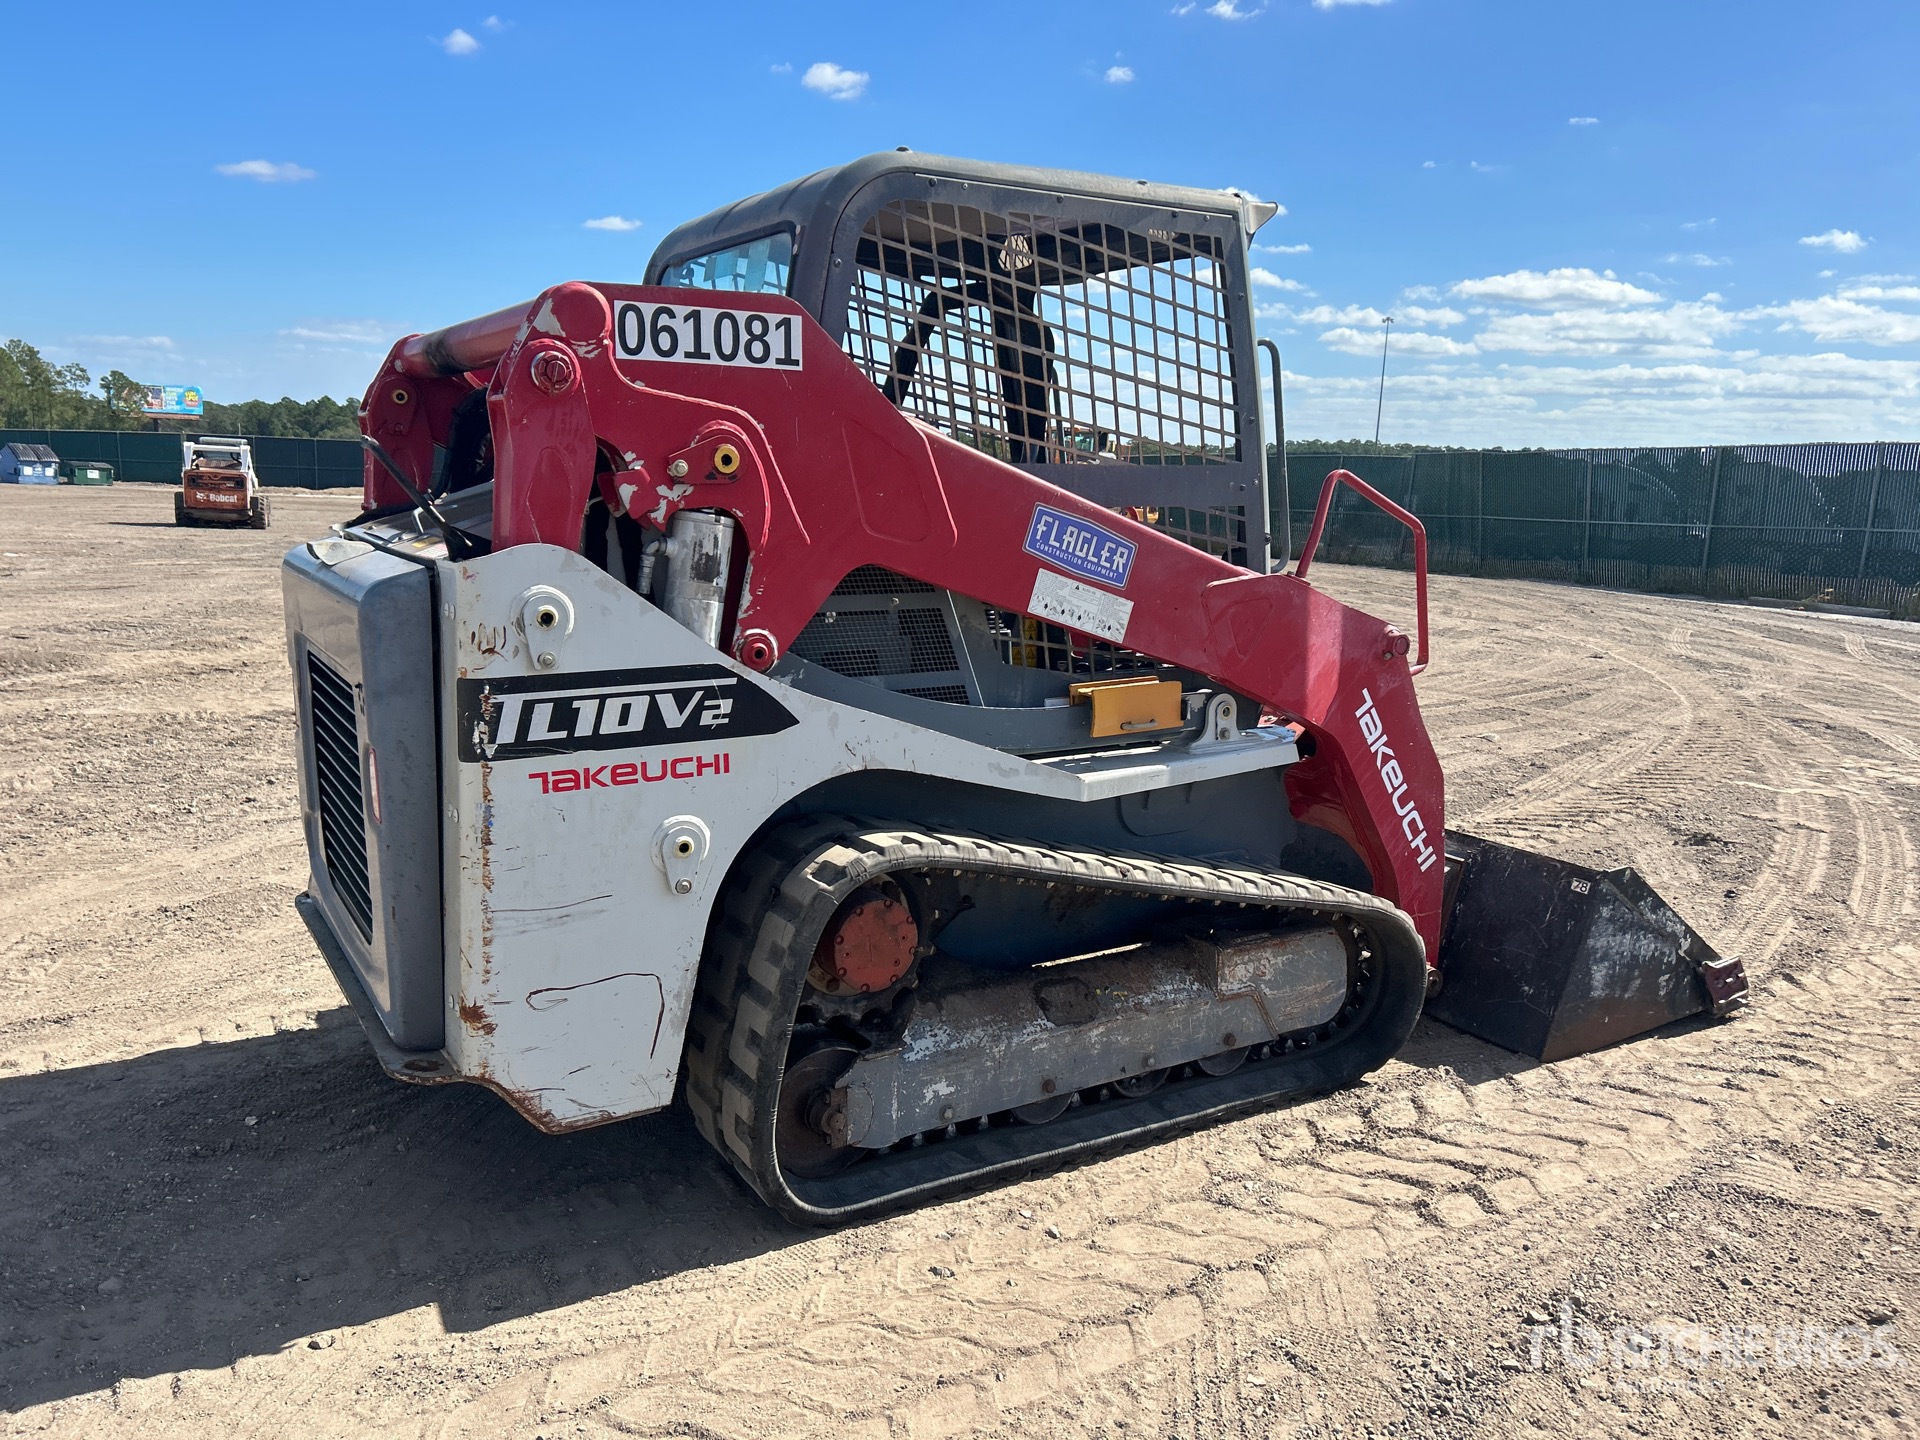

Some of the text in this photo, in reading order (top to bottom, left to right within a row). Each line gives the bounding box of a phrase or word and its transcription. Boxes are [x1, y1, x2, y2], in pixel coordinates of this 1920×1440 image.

[617, 303, 800, 367] 061081
[209, 493, 238, 503] Bobcat
[1036, 514, 1129, 573] FLAGLER
[1036, 542, 1118, 579] CONSTRUCTION EQUIPMENT
[1572, 879, 1589, 893] 78
